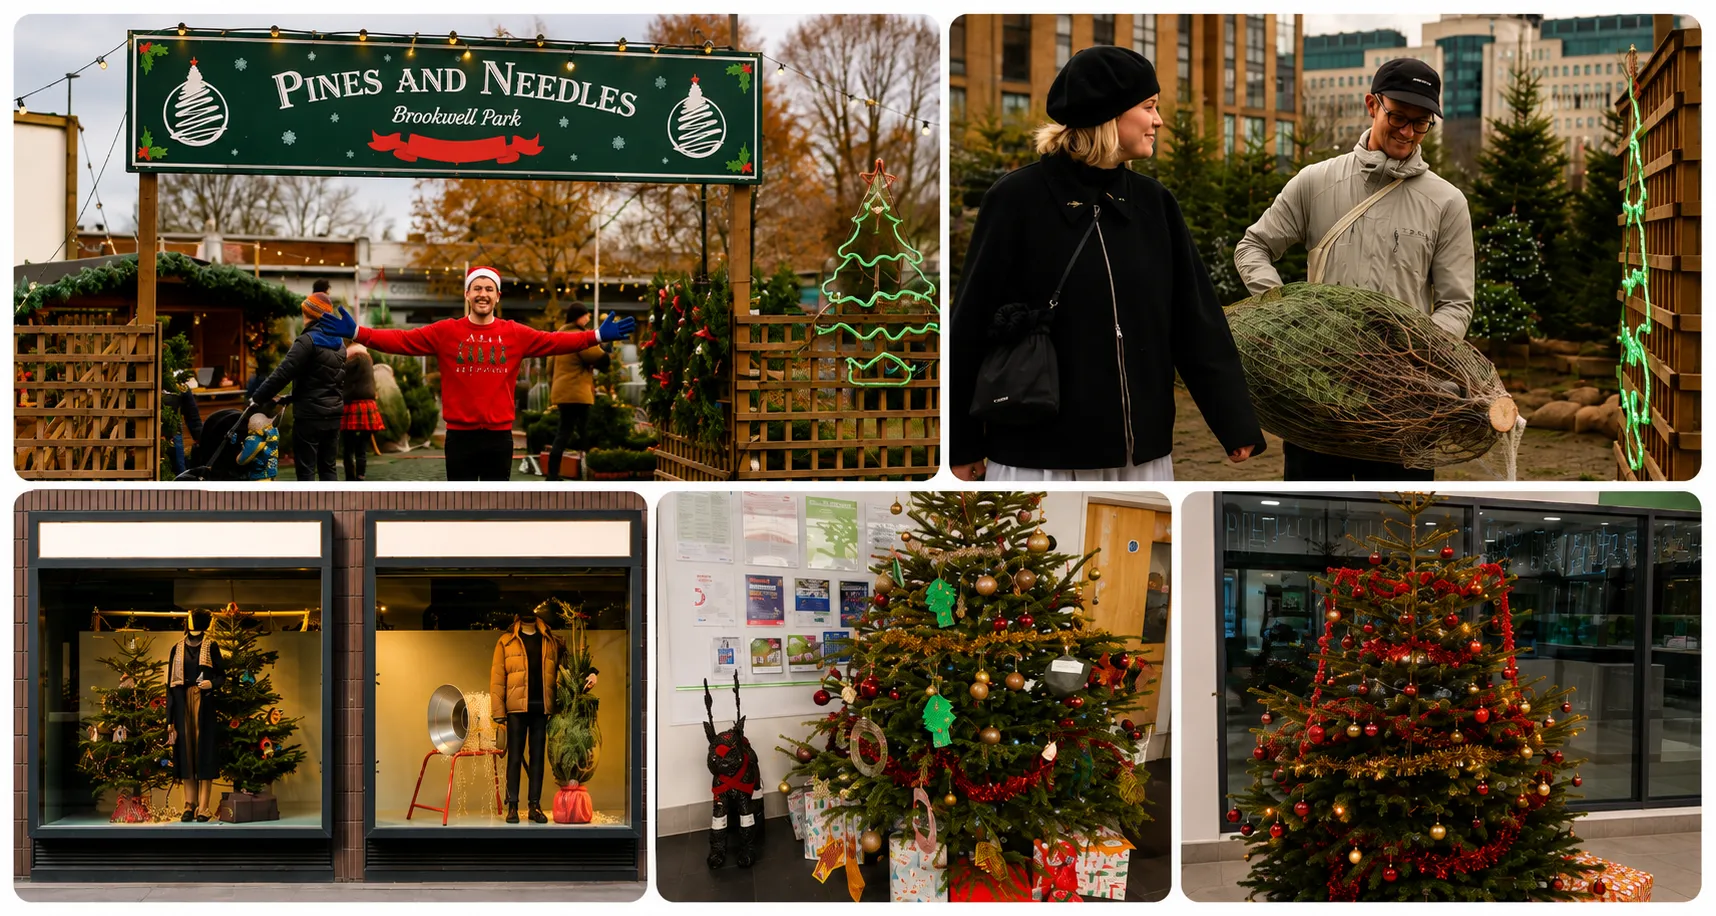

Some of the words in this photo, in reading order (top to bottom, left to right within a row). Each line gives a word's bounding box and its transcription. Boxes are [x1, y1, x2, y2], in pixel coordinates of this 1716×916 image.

[272, 69, 383, 110] PINES
[395, 68, 467, 93] AND
[480, 60, 637, 118] NEEDLES
[391, 105, 478, 126] Brookwell
[480, 108, 522, 127] Park
